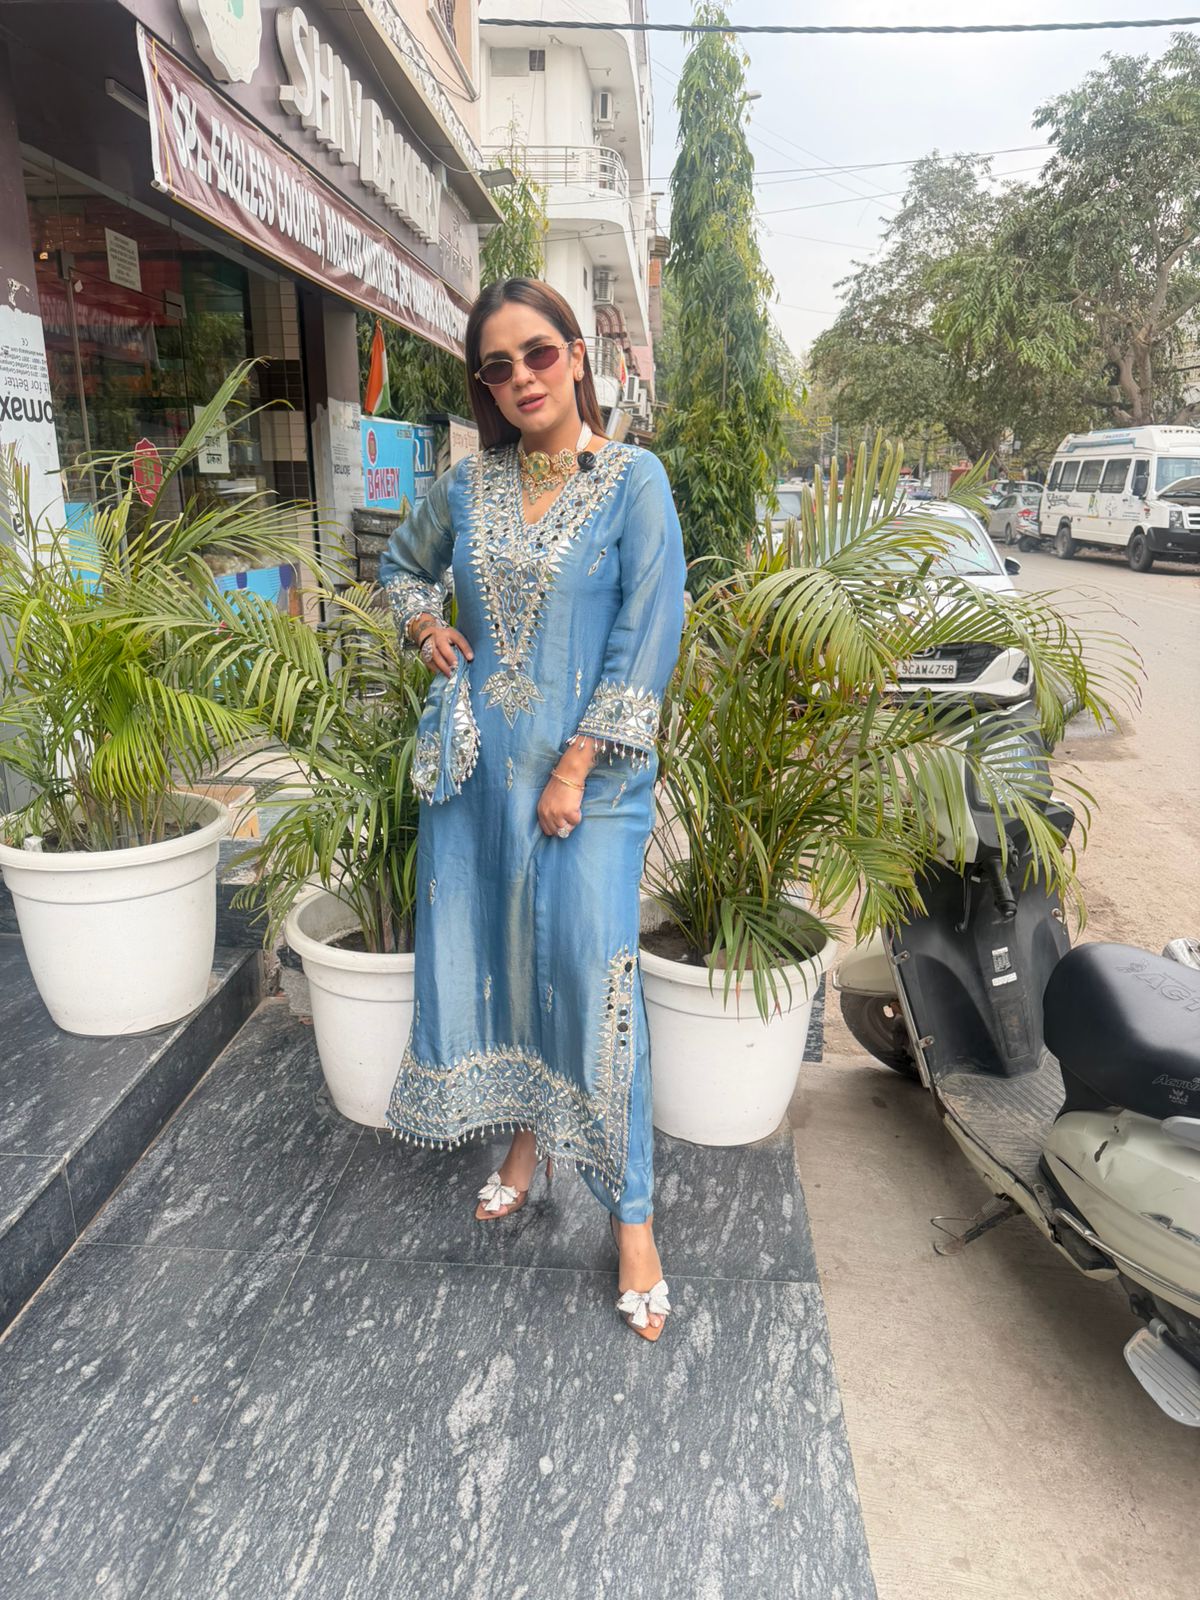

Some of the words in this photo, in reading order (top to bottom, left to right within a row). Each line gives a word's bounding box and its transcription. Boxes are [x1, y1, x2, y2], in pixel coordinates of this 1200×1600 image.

[275, 7, 362, 167] SHIV
[360, 98, 441, 245] BAKERY
[211, 115, 275, 226] EGGLESS
[4, 376, 29, 392] Better
[31, 380, 42, 394] for
[367, 467, 400, 501] BAKERY
